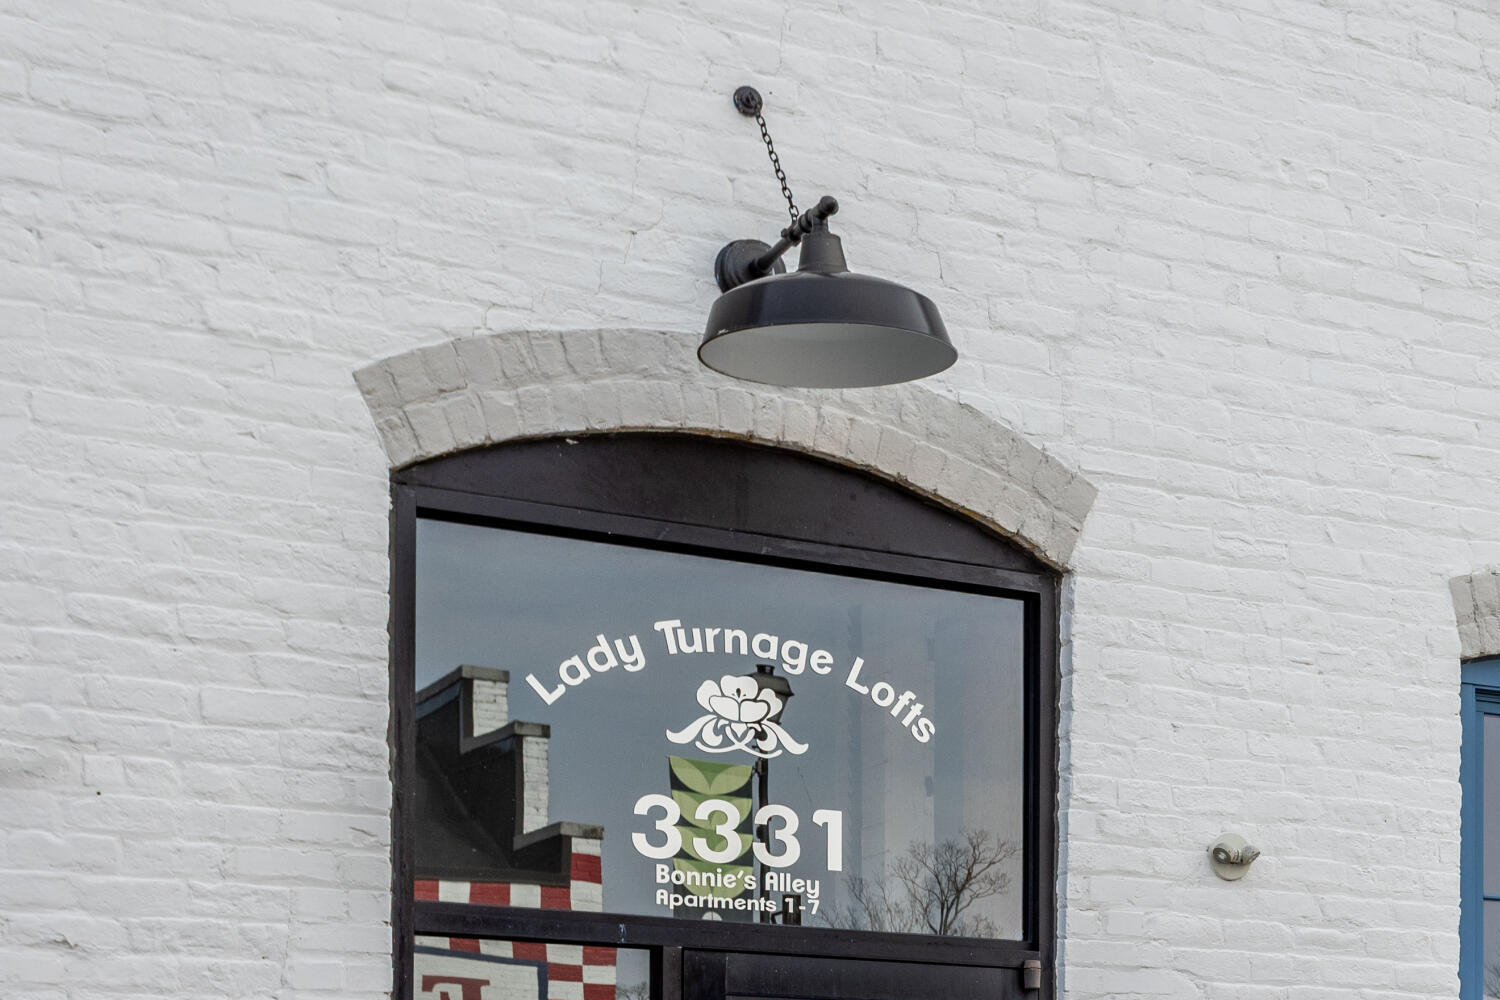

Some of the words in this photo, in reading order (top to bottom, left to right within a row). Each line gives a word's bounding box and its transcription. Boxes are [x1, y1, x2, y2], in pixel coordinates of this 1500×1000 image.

[525, 633, 646, 706] Lady
[653, 618, 834, 675] Turnage
[844, 656, 936, 744] Lofts
[631, 793, 844, 872] 3331
[655, 863, 757, 890] Bonnie's
[764, 871, 820, 899] Alley
[655, 889, 777, 912] Apartments
